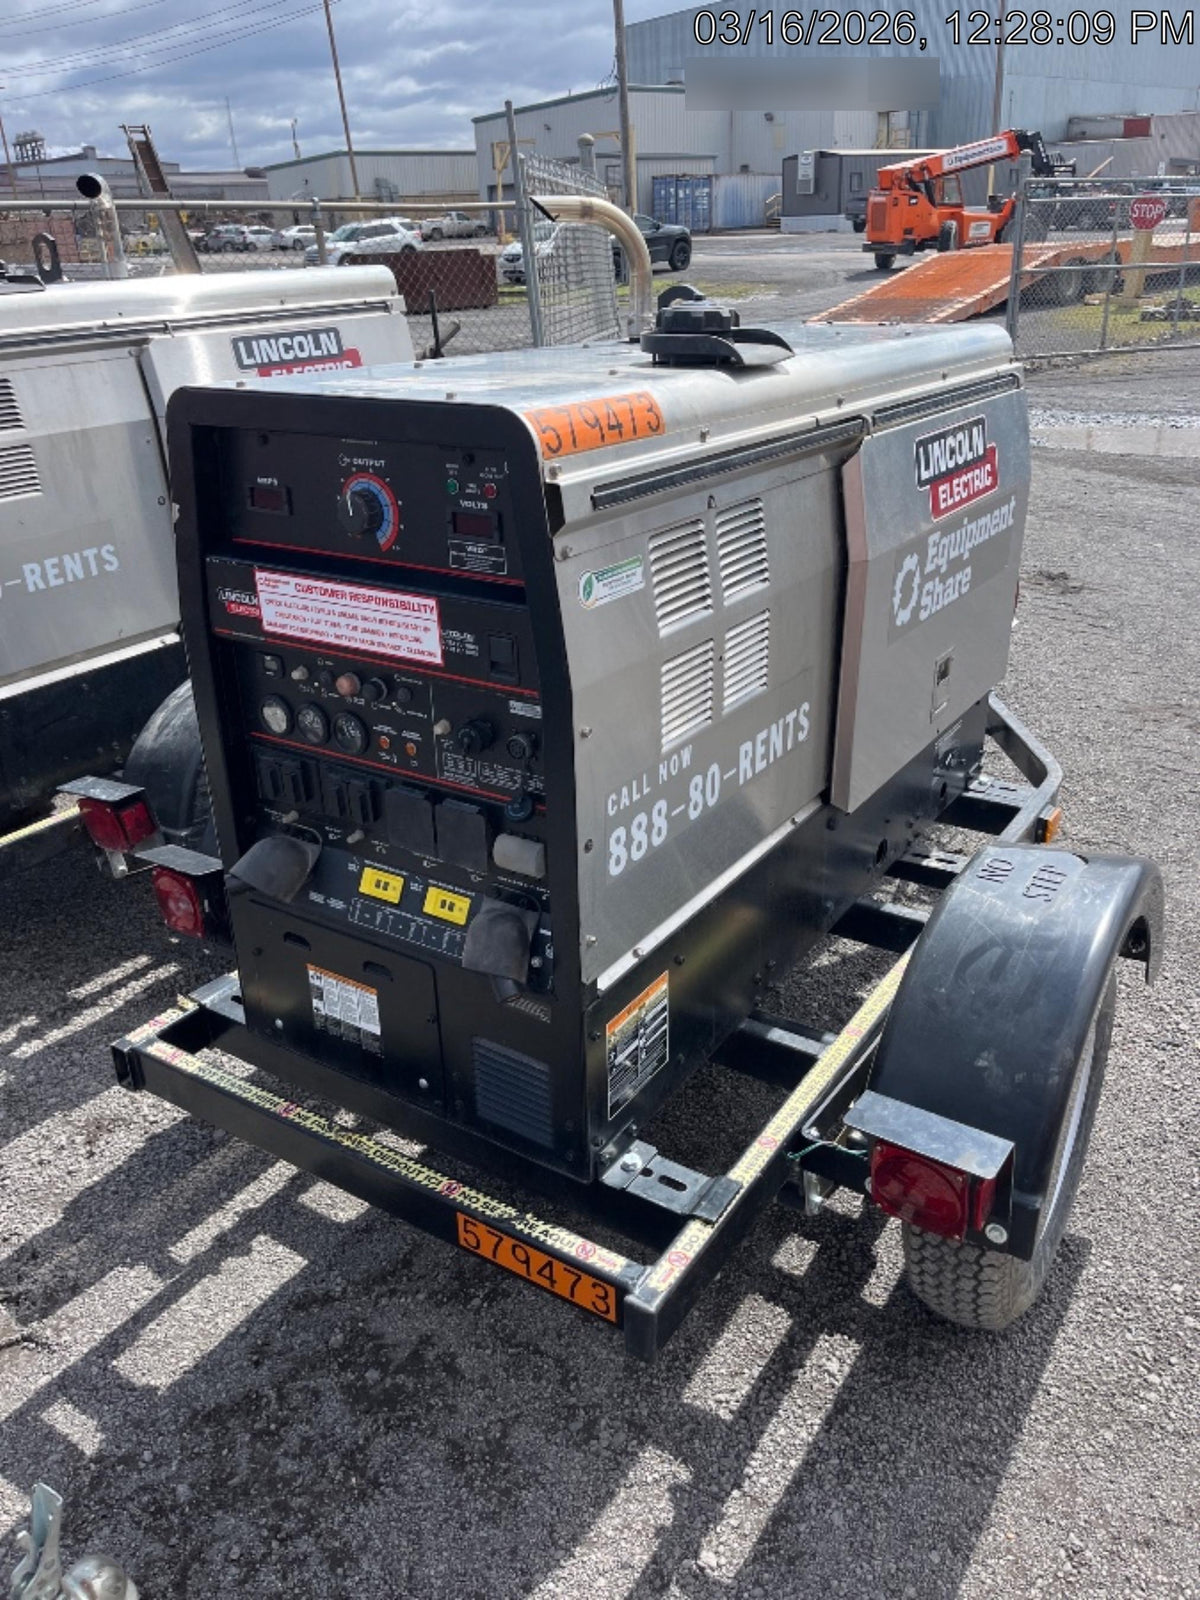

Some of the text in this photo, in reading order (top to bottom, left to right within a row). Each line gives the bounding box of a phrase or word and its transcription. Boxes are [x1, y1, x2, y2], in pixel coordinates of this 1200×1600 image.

[1132, 203, 1164, 219] STOP
[237, 331, 339, 366] LINCOLN
[532, 393, 661, 454] 579473
[353, 457, 386, 468] OUTPUT
[918, 424, 985, 480] LINCOLN
[938, 463, 993, 510] ELECTRIC
[924, 494, 1016, 575] Equipment
[0, 543, 120, 594] -RENTS
[919, 565, 972, 622] Share
[294, 582, 347, 600] CUSTOMER
[348, 590, 435, 615] RESPONSIBILITY
[607, 744, 693, 817] CALL NOW
[608, 701, 811, 876] 888-80-RENTS
[976, 858, 1016, 885] NO
[1021, 864, 1068, 902] STEP
[372, 1148, 424, 1178] DEBOUT
[422, 1171, 444, 1187] ICI
[458, 1190, 481, 1204] NO
[537, 1227, 575, 1250] AQUI
[463, 1217, 611, 1316] 579473
